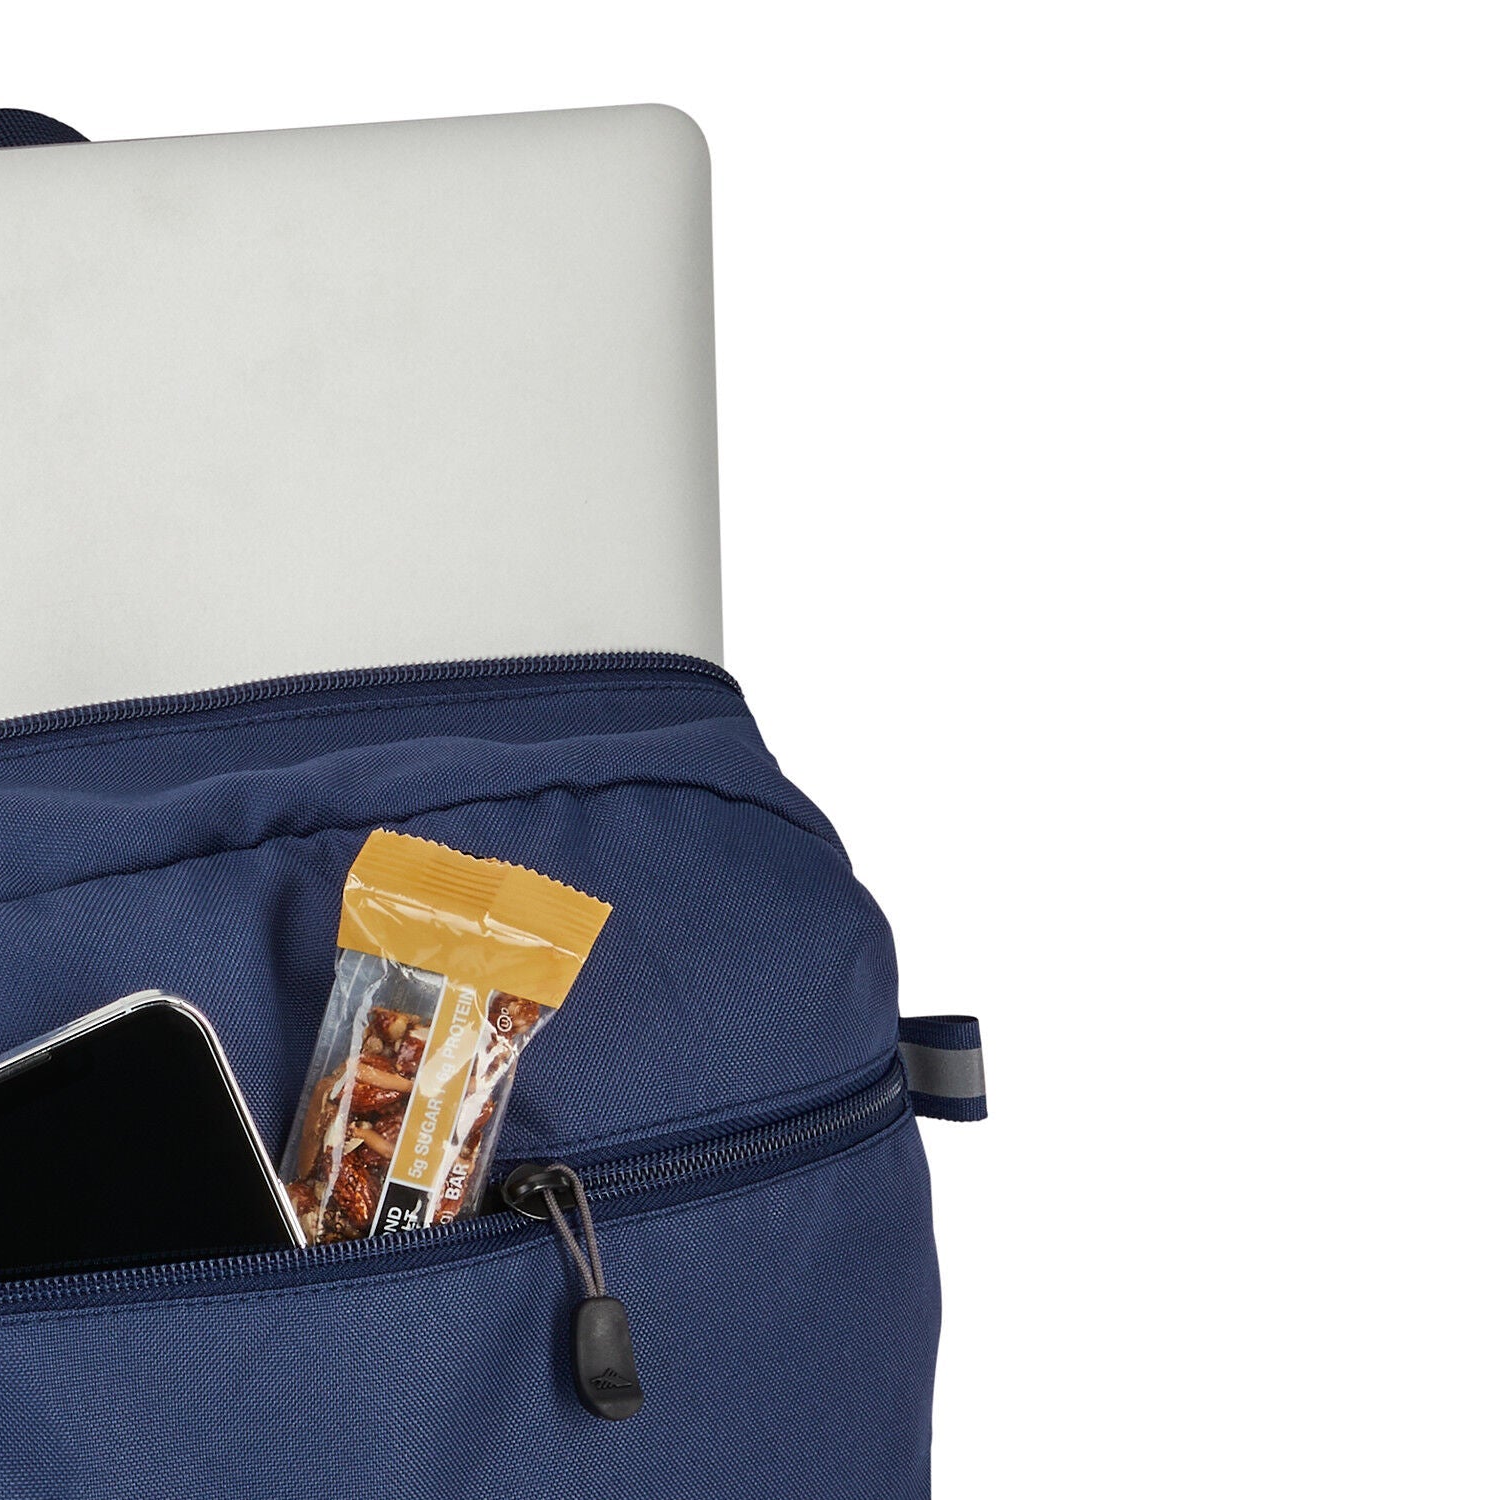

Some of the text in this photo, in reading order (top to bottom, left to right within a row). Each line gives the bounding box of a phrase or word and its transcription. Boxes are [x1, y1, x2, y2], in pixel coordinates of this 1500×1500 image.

[443, 986, 476, 1059] PROTEIN
[414, 1096, 443, 1156] SUGAR
[408, 1158, 428, 1179] 5g
[445, 1163, 469, 1200] BAR
[383, 1206, 402, 1236] ND
